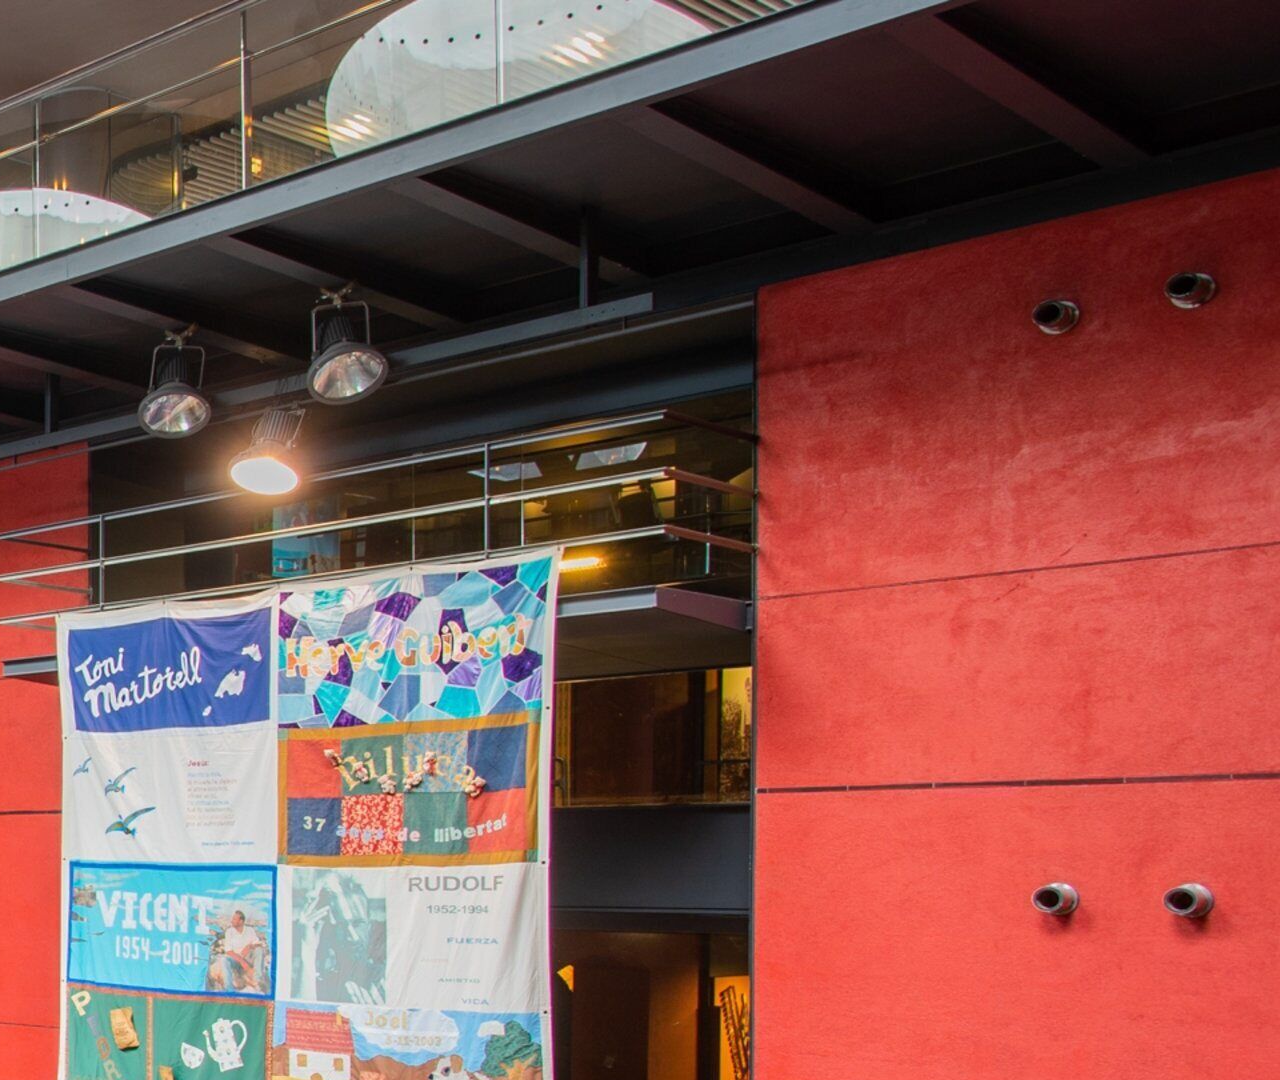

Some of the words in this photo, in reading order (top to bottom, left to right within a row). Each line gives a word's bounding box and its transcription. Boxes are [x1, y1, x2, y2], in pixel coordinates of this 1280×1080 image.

[395, 612, 534, 668] Guibert
[74, 647, 125, 687] Toni
[83, 646, 203, 718] Martorell
[302, 815, 326, 832] 37
[398, 827, 420, 842] de
[434, 813, 508, 844] llibertat
[407, 875, 504, 892] RUDOLF
[95, 890, 215, 936] VICENT
[446, 936, 499, 945] FUERZA
[364, 1009, 409, 1031] Joel
